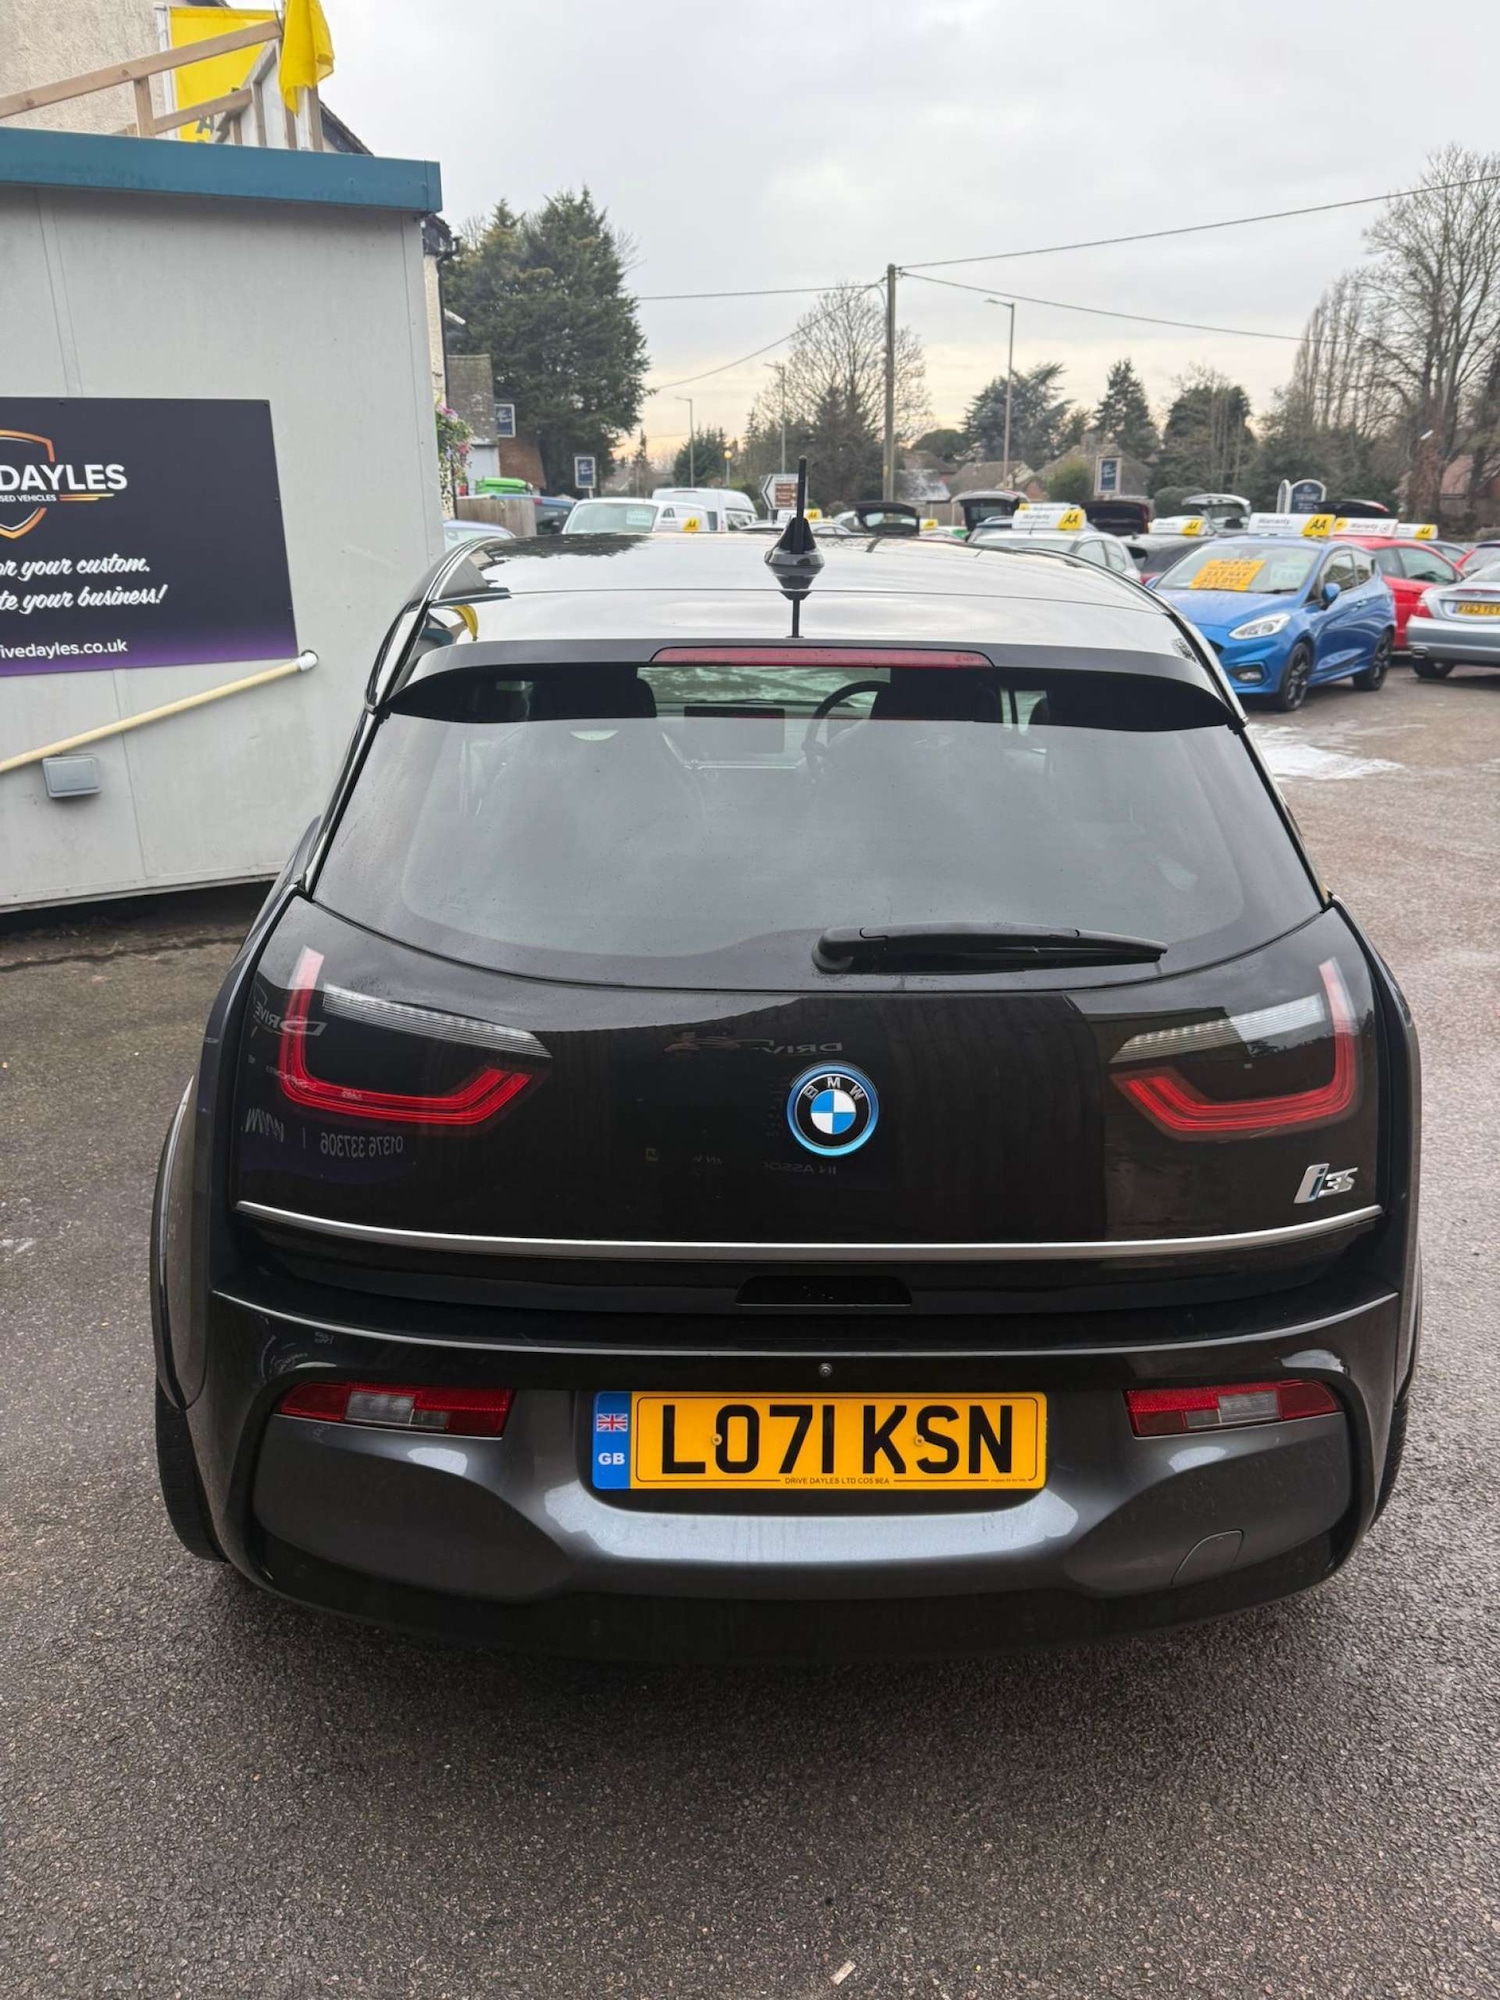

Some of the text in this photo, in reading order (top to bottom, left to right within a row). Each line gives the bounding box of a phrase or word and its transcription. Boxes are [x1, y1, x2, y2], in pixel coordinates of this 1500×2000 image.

[0, 464, 128, 491] DAYLES
[16, 494, 57, 502] VEHICLES
[1063, 513, 1080, 524] AA
[1309, 518, 1328, 530] AA
[18, 558, 73, 581] your
[76, 553, 150, 574] custom.
[19, 590, 74, 615] your
[78, 584, 169, 607] business!
[803, 1077, 865, 1101] BMW
[661, 1404, 1012, 1474] LO71 KSN
[598, 1452, 626, 1466] GB
